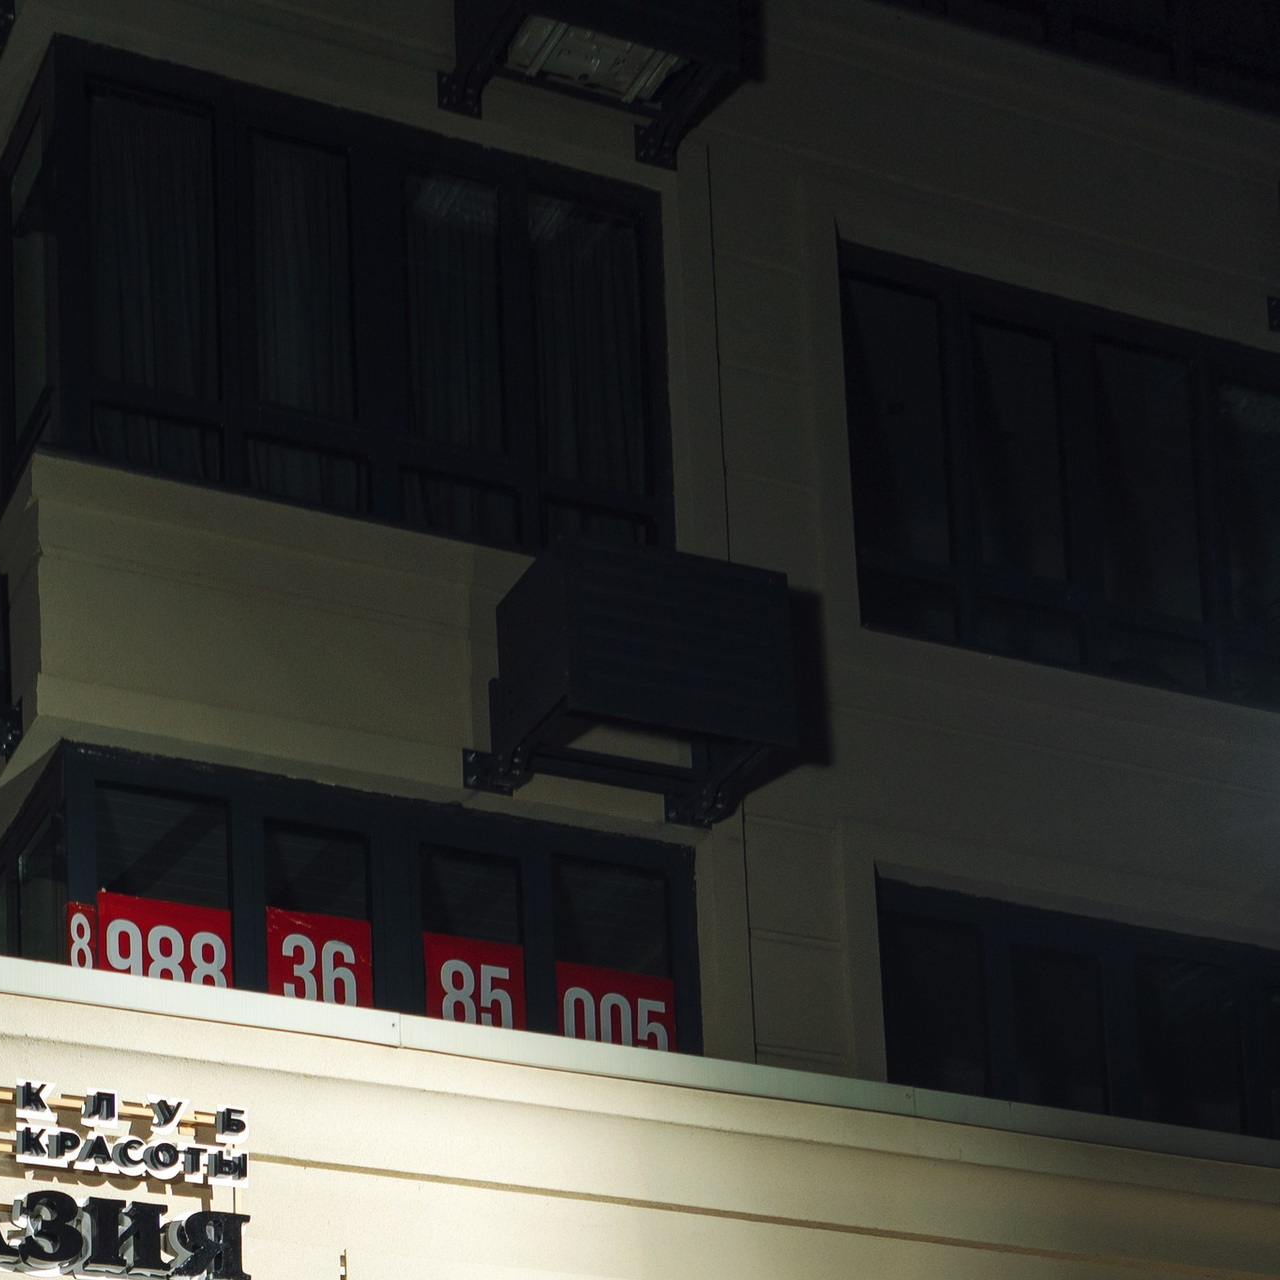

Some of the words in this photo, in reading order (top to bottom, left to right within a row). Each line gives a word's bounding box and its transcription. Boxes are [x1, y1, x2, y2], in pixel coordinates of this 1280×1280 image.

[70, 912, 93, 969] 8
[106, 919, 227, 989] 988
[282, 933, 357, 1007] 36
[440, 959, 513, 1030] 85
[563, 986, 669, 1052] 005
[17, 1122, 249, 1187] КРАСОТЫ
